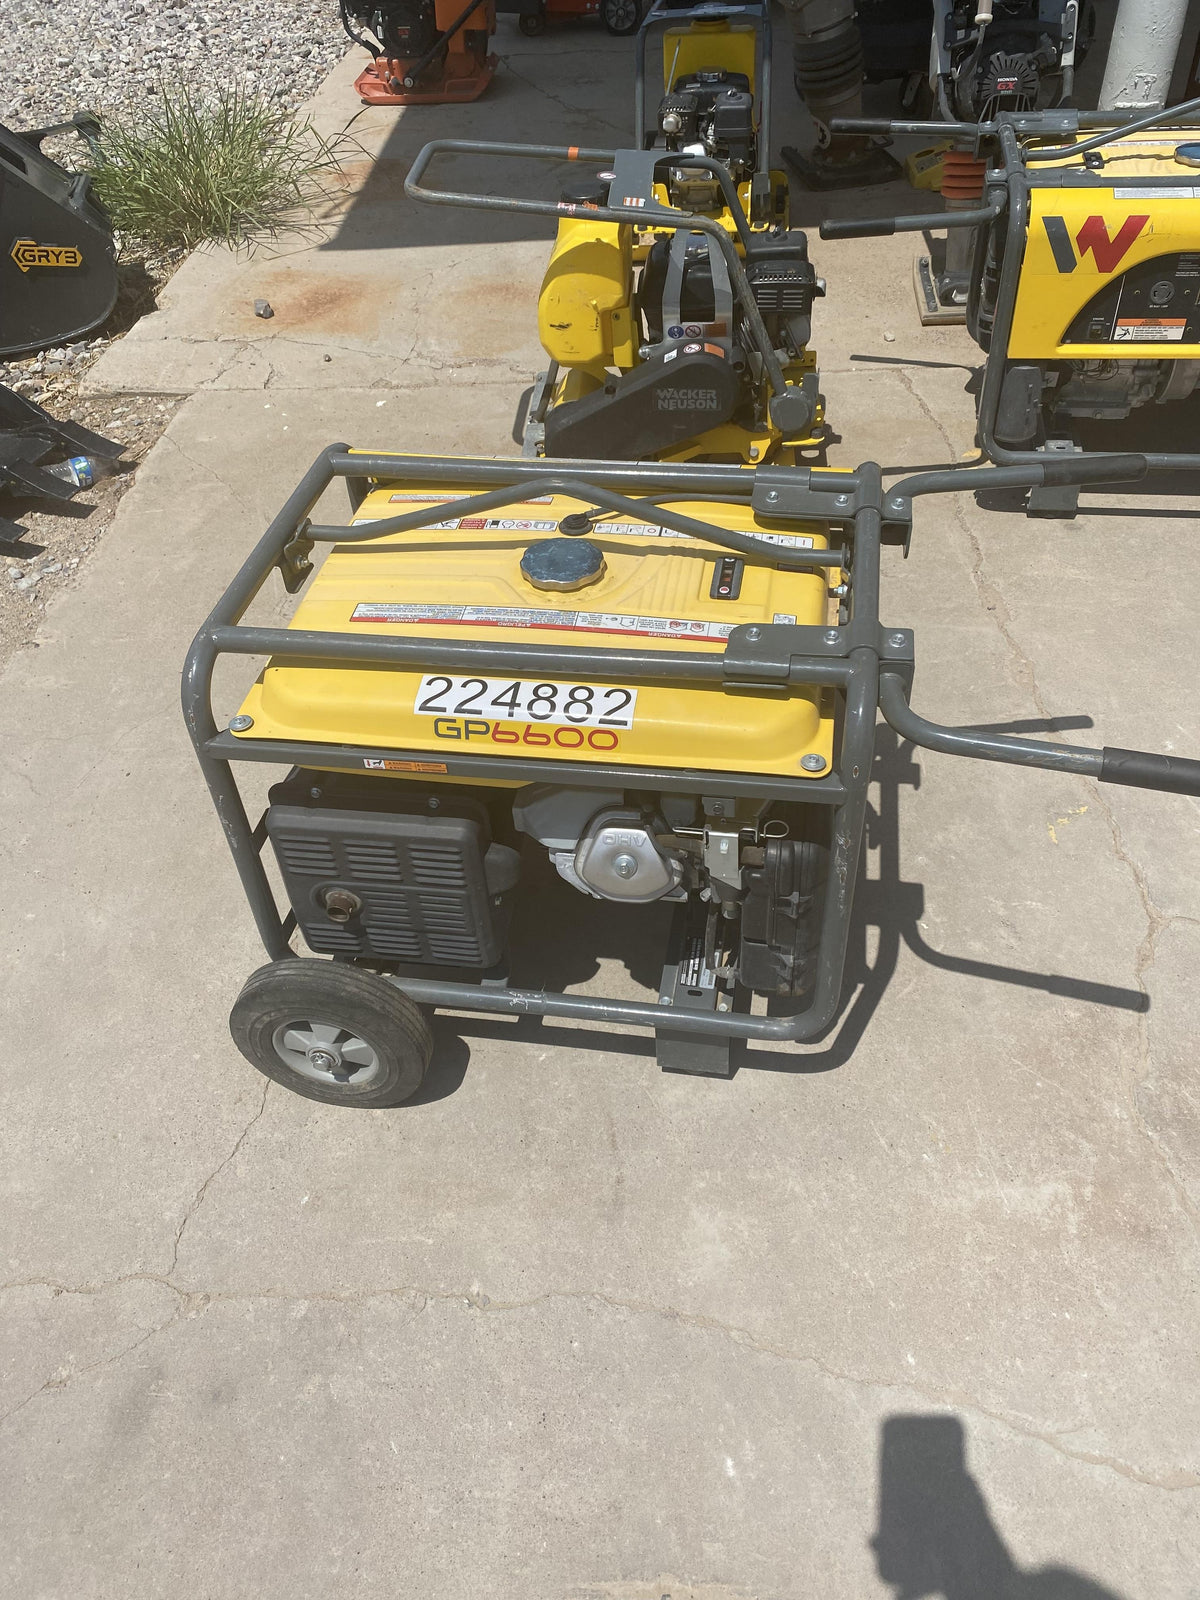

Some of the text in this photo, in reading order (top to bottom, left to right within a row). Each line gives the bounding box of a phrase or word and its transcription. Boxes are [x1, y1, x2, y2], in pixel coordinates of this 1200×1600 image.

[997, 82, 1016, 90] GX
[657, 388, 717, 400] WACKER
[657, 399, 718, 409] NEUSON
[418, 676, 632, 726] 224882
[434, 717, 619, 750] GP6600
[602, 833, 648, 847] OHV
